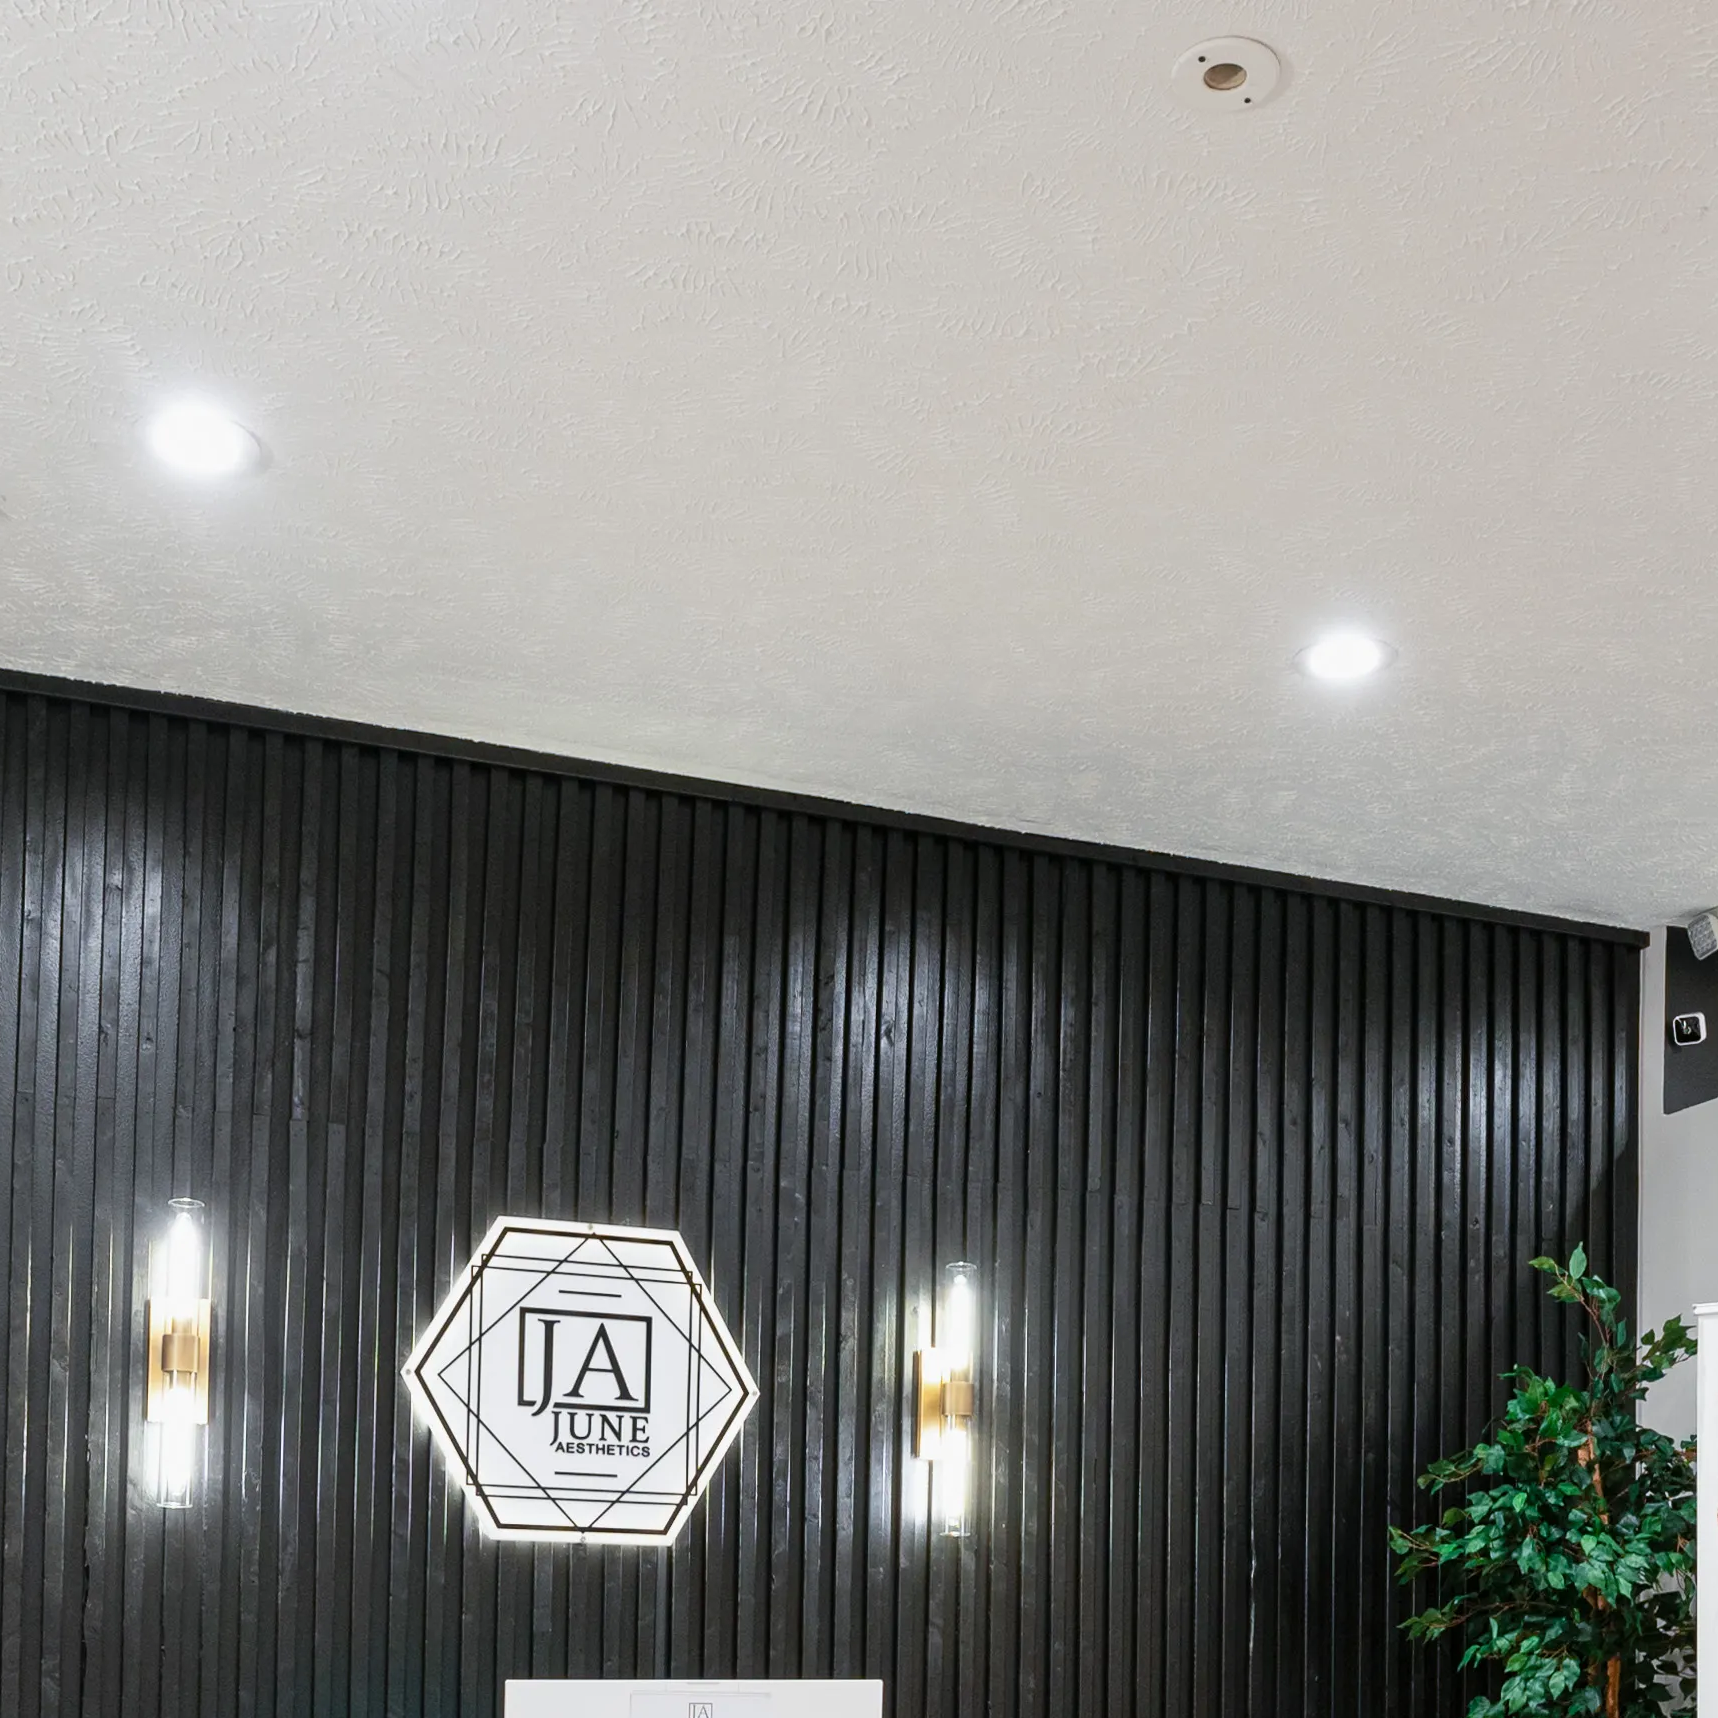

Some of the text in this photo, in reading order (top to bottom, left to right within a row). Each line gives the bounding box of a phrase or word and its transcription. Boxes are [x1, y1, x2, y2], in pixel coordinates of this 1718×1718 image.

[531, 1318, 639, 1417] JA
[549, 1410, 650, 1446] JUNE
[554, 1441, 651, 1458] AESTHETICS
